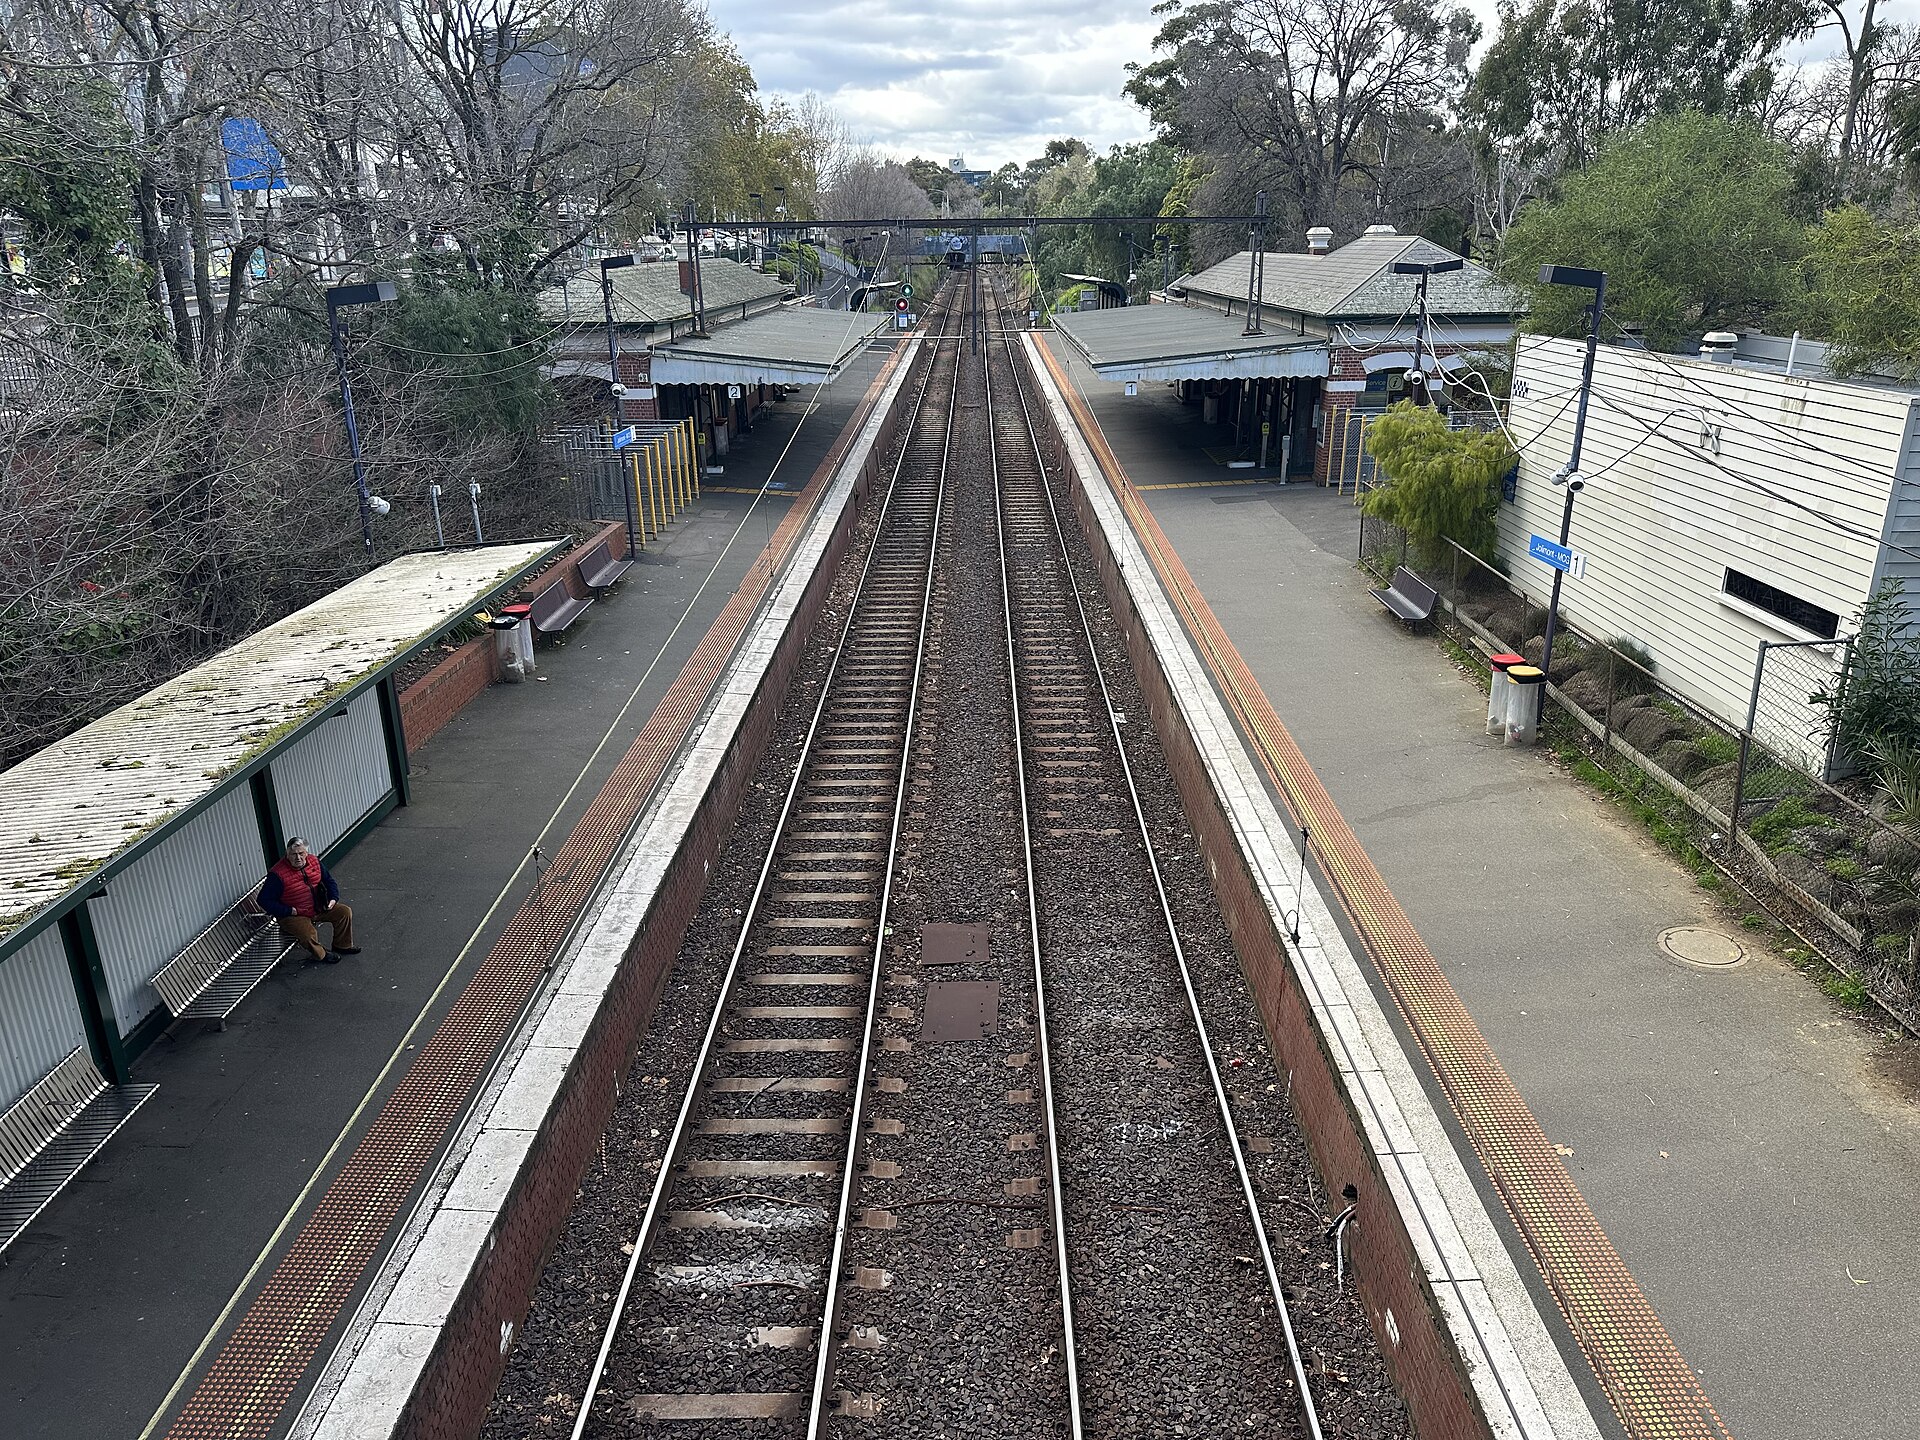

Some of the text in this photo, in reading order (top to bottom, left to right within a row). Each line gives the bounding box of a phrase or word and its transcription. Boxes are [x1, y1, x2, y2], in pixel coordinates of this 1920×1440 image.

[731, 387, 738, 397] 2
[1129, 384, 1133, 394] 1
[1557, 552, 1570, 564] MCG
[1573, 556, 1579, 575] 1
